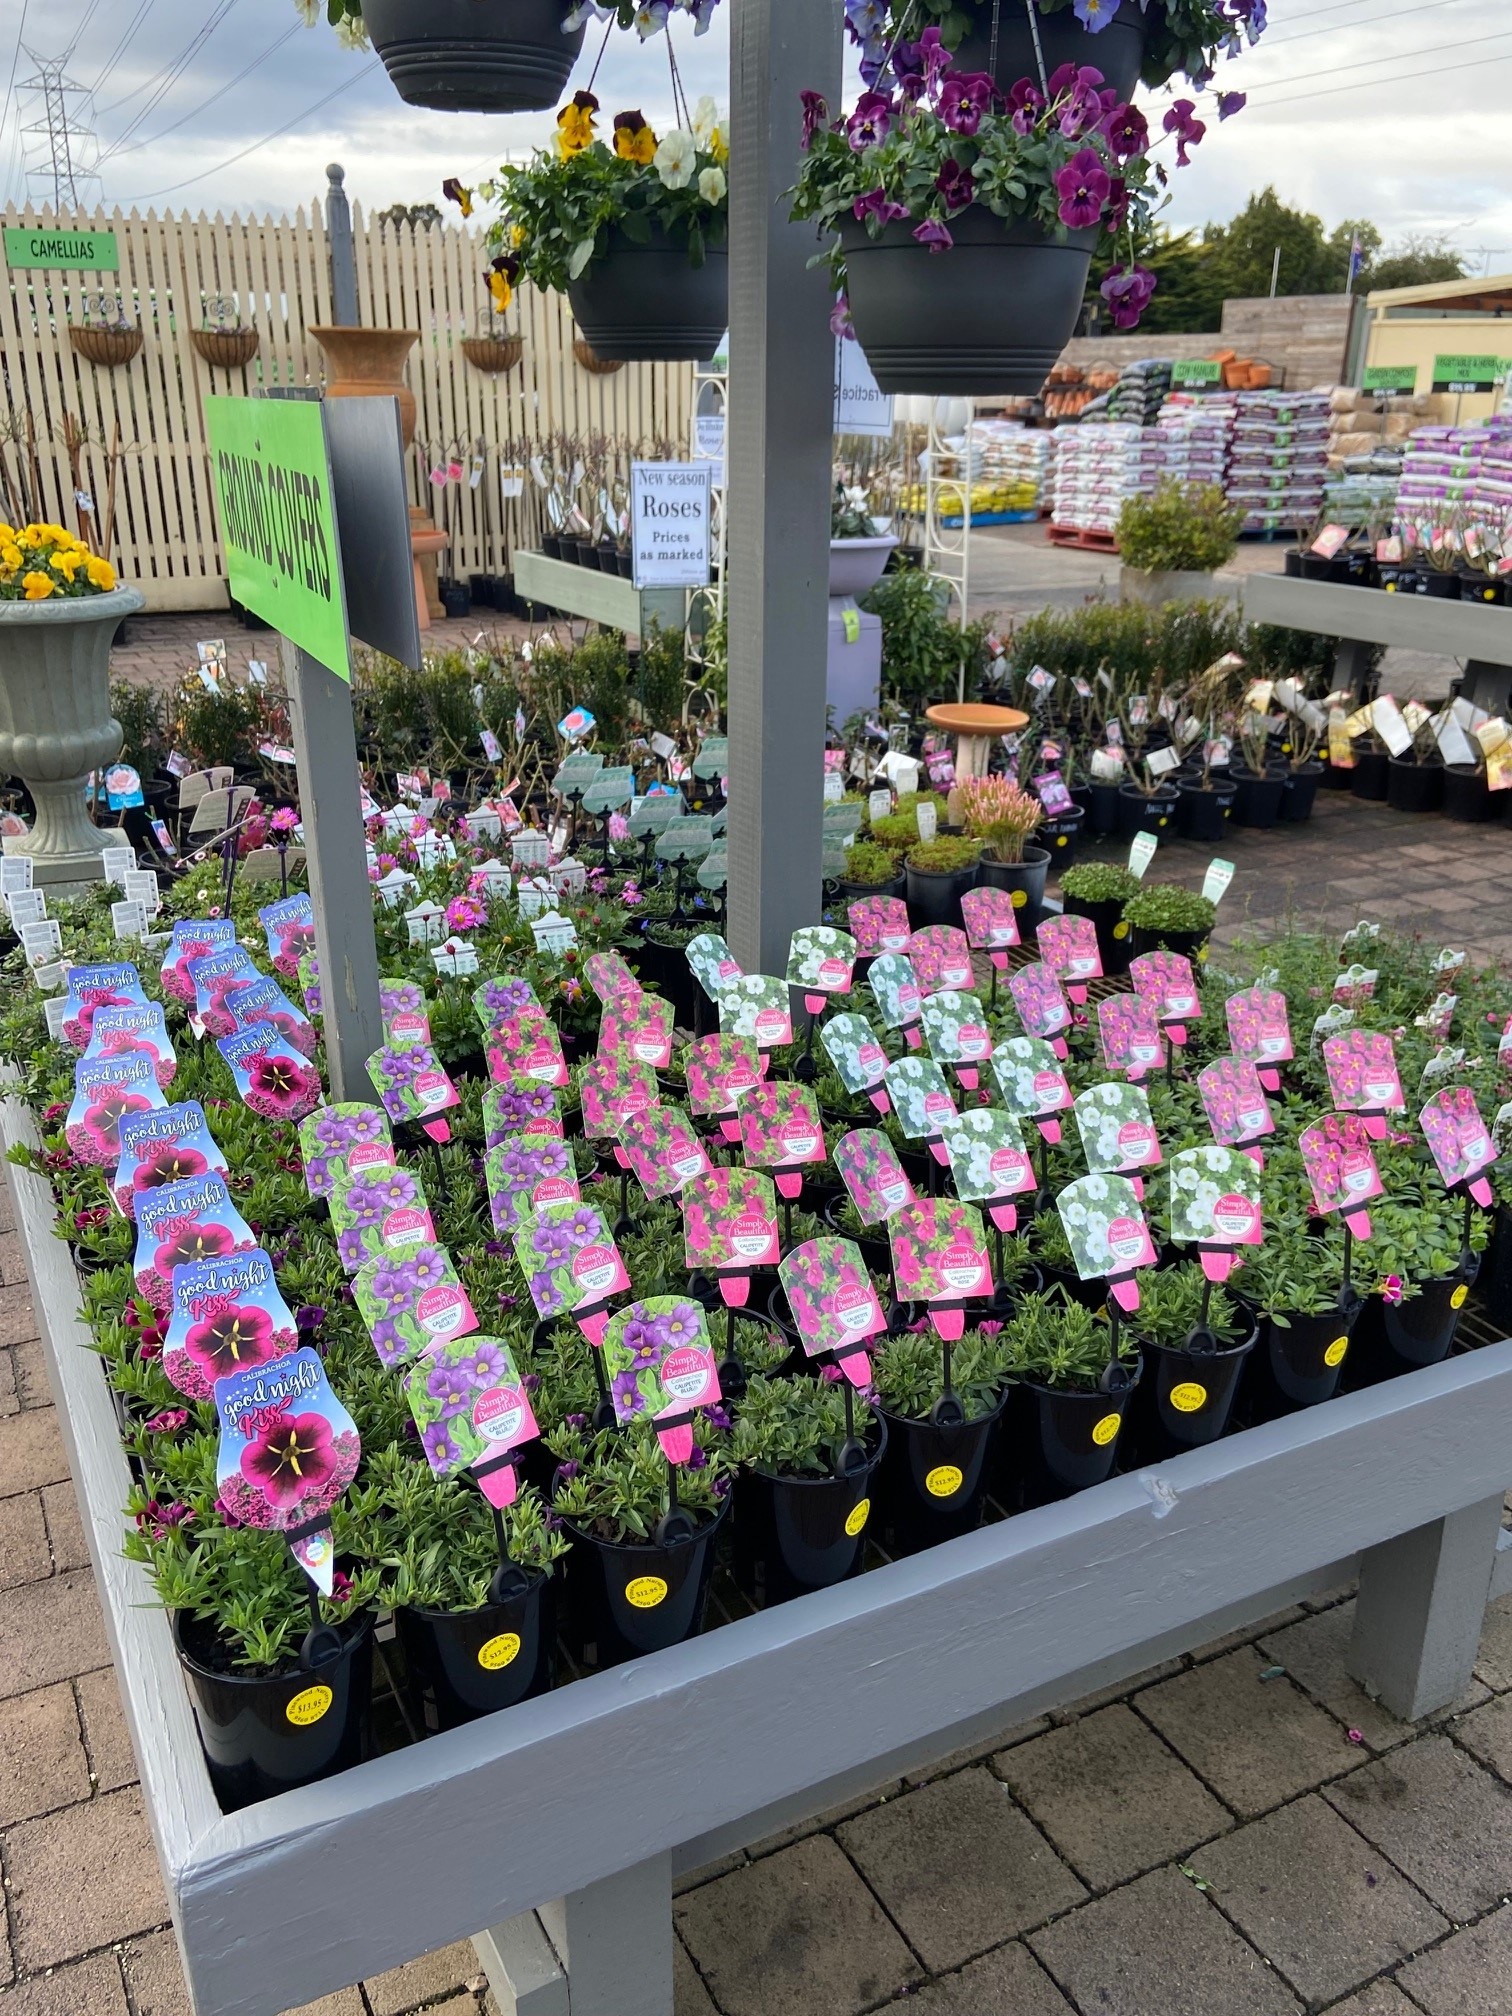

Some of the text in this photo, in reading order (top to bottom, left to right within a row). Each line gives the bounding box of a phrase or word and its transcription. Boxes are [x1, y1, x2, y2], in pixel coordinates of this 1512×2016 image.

[30, 239, 95, 259] CAMELLIAS
[639, 469, 706, 486] New season
[642, 494, 702, 518] Roses
[218, 449, 331, 602] GROUND COVERS
[652, 531, 690, 543] Prices
[640, 548, 703, 560] as marked
[72, 970, 135, 994] good night
[96, 1010, 159, 1036] good night
[80, 1060, 151, 1091] good night
[88, 1083, 124, 1103] Kiss
[124, 1110, 203, 1149] good night
[135, 1136, 174, 1162] Kiss
[354, 1146, 381, 1157] Simply
[155, 1180, 199, 1197] CALIBRACHOA
[539, 1184, 566, 1194] Simply
[141, 1182, 225, 1230] good night
[1220, 1199, 1248, 1209] Simply
[153, 1212, 195, 1242] Kiss
[387, 1220, 422, 1234] Beautiful
[388, 1212, 417, 1225] Simply
[736, 1219, 765, 1230] Simply
[733, 1227, 769, 1235] Beautiful
[196, 1257, 244, 1272] CALIBRACHOA
[577, 1248, 605, 1264] Simply
[577, 1255, 612, 1273] Beautiful
[943, 1259, 979, 1267] Beautiful
[945, 1251, 974, 1261] Simply
[178, 1260, 271, 1306] good night
[421, 1289, 450, 1308] Simply
[837, 1288, 862, 1301] Simply
[837, 1296, 869, 1311] Beautiful
[188, 1291, 236, 1321] Kiss
[421, 1297, 456, 1317] Beautiful
[665, 1360, 706, 1377] Beautiful
[668, 1352, 699, 1368] Simply
[241, 1359, 292, 1383] CALIBRACHOA
[223, 1360, 322, 1426] good night
[478, 1391, 510, 1410] Simply
[477, 1397, 516, 1420] Beautiful
[238, 1398, 289, 1440] Kiss
